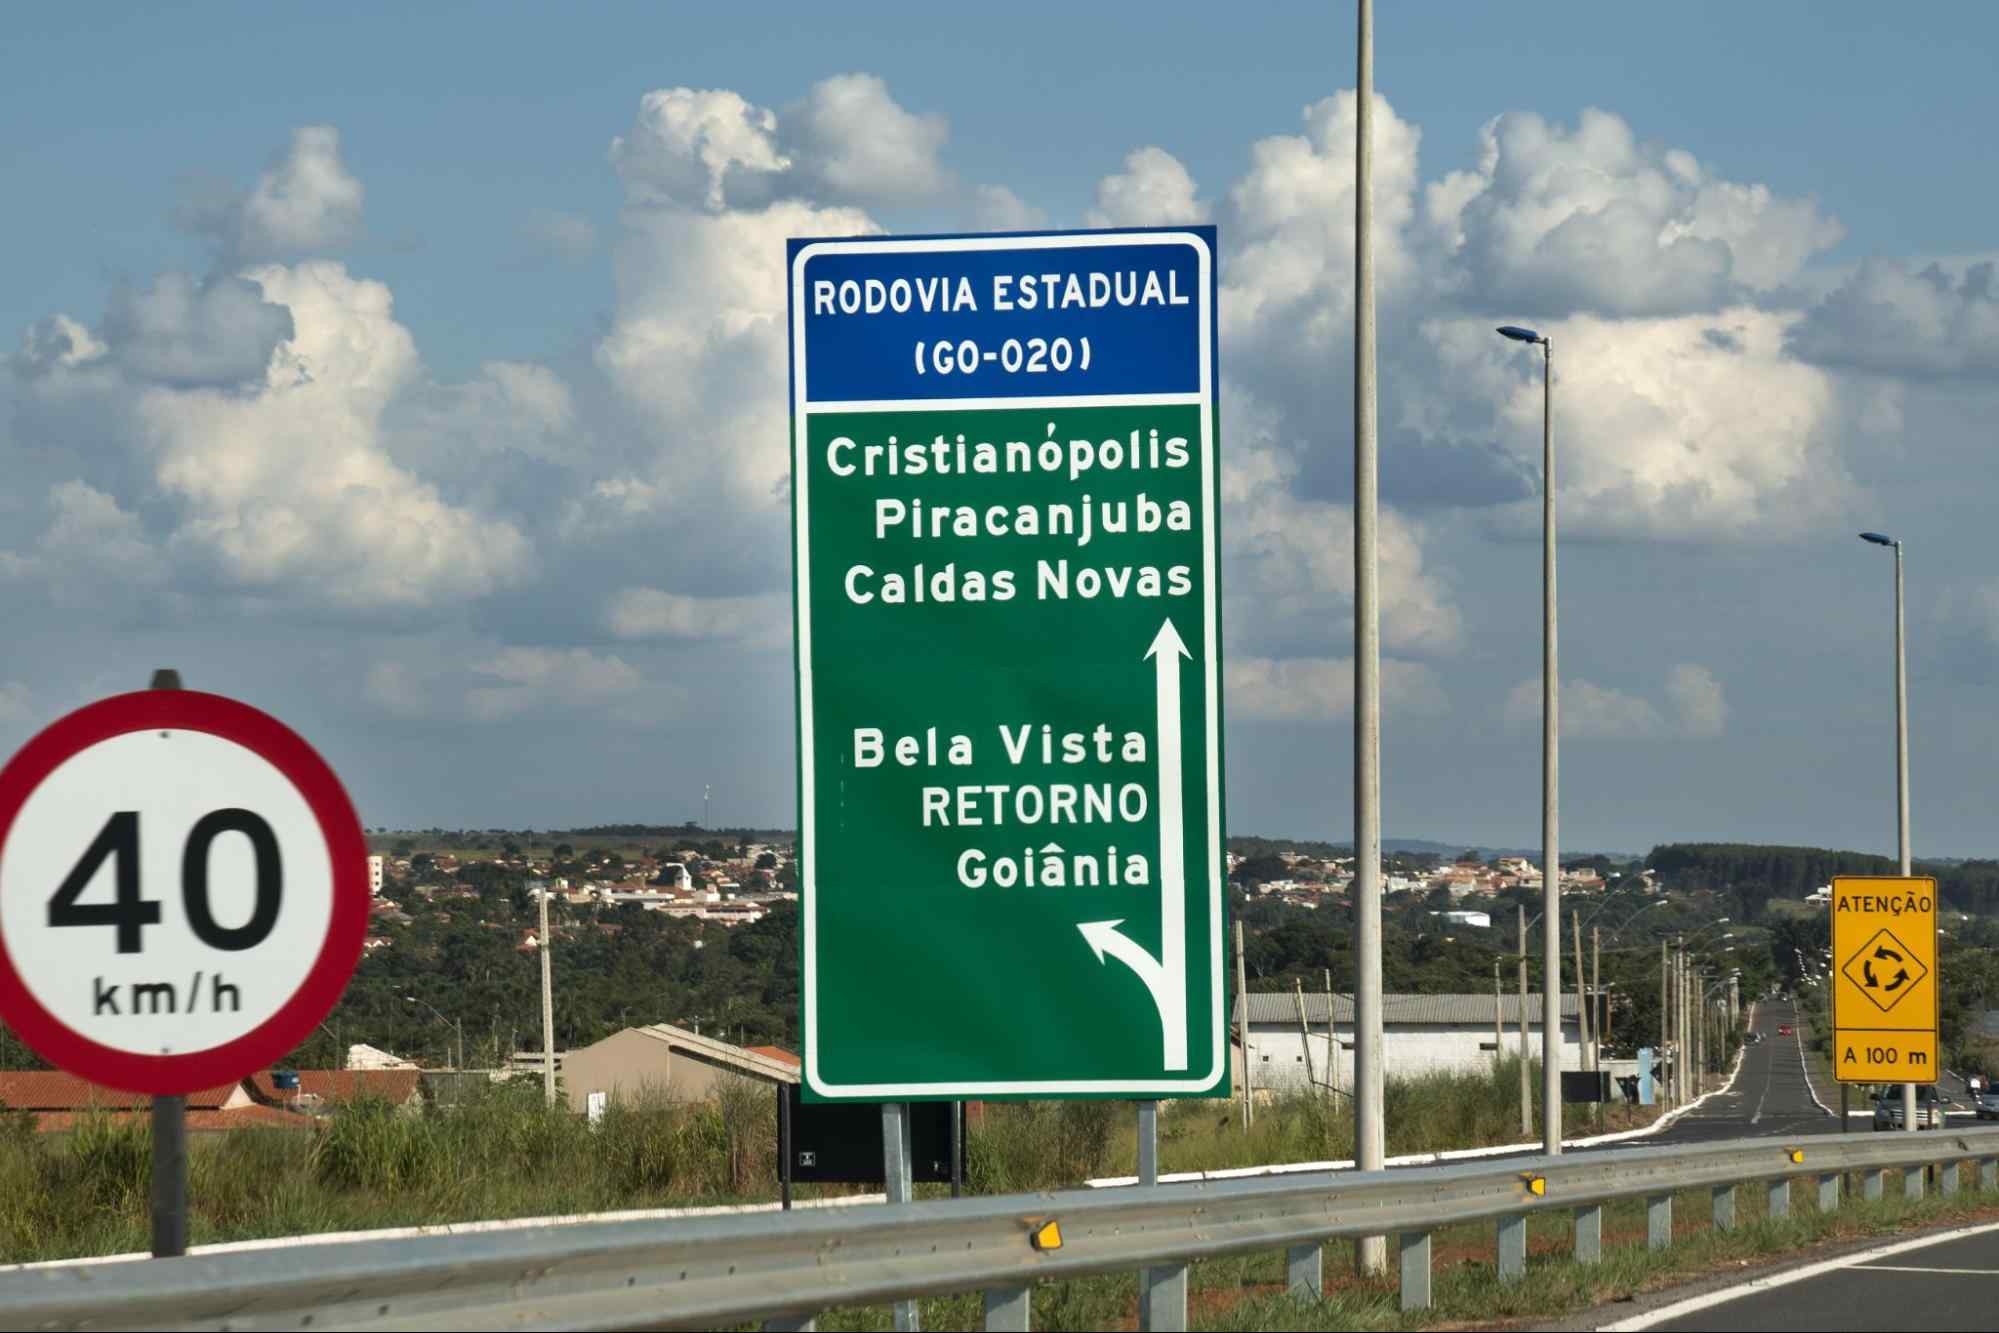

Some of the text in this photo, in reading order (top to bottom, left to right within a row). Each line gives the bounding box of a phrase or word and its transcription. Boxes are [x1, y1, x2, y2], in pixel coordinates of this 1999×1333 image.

[814, 270, 1189, 315] RODOVIA ESTADUAL
[915, 337, 1091, 375] (GO-020)
[827, 422, 1190, 481] Cristianópolis
[876, 492, 1191, 547] Piracanjuba
[844, 559, 1192, 605] Caldas Novas
[854, 723, 1146, 768] Bela Vista
[922, 783, 1148, 827] RETORNO
[47, 807, 284, 954] 40
[957, 842, 1149, 889] Goiânia
[1837, 891, 1932, 916] ATENÇÃO
[94, 971, 240, 1016] km/h
[1843, 1046, 1927, 1065] A 100 m
